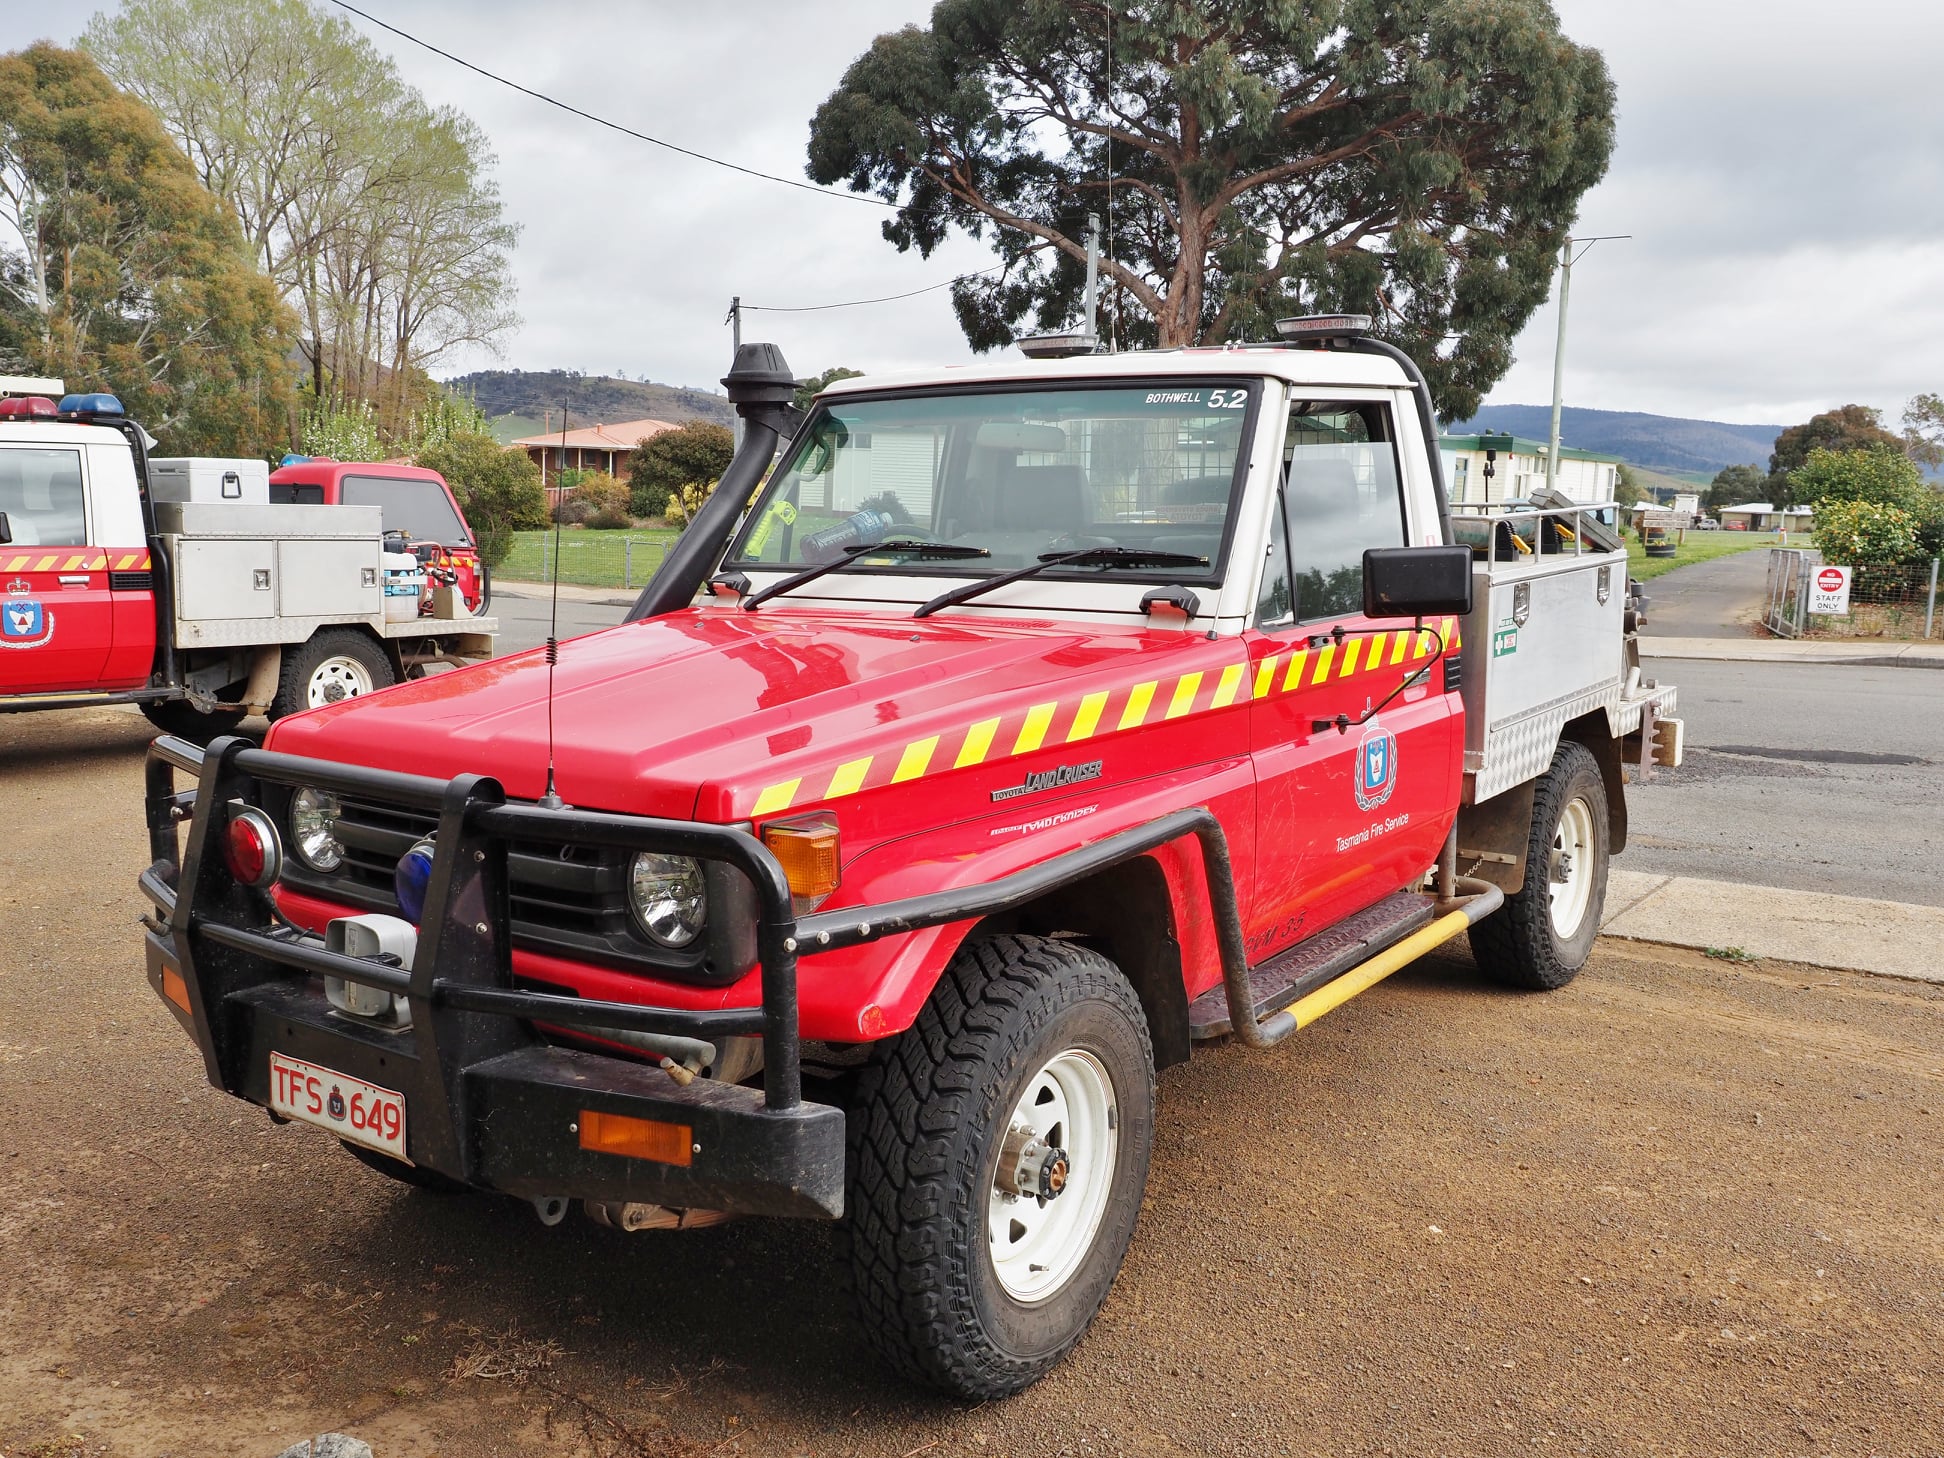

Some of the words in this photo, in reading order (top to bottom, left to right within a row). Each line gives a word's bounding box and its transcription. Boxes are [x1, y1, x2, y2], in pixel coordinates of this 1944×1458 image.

[1145, 393, 1200, 404] BOTHWELL
[1207, 389, 1248, 409] 5.2
[1815, 594, 1842, 602] STAFF
[995, 785, 1026, 800] TOYOTA
[1336, 828, 1369, 852] Tasmania
[1370, 823, 1384, 839] Fire
[1384, 812, 1409, 833] Service
[273, 1064, 323, 1115] TFS
[350, 1092, 401, 1141] 649
